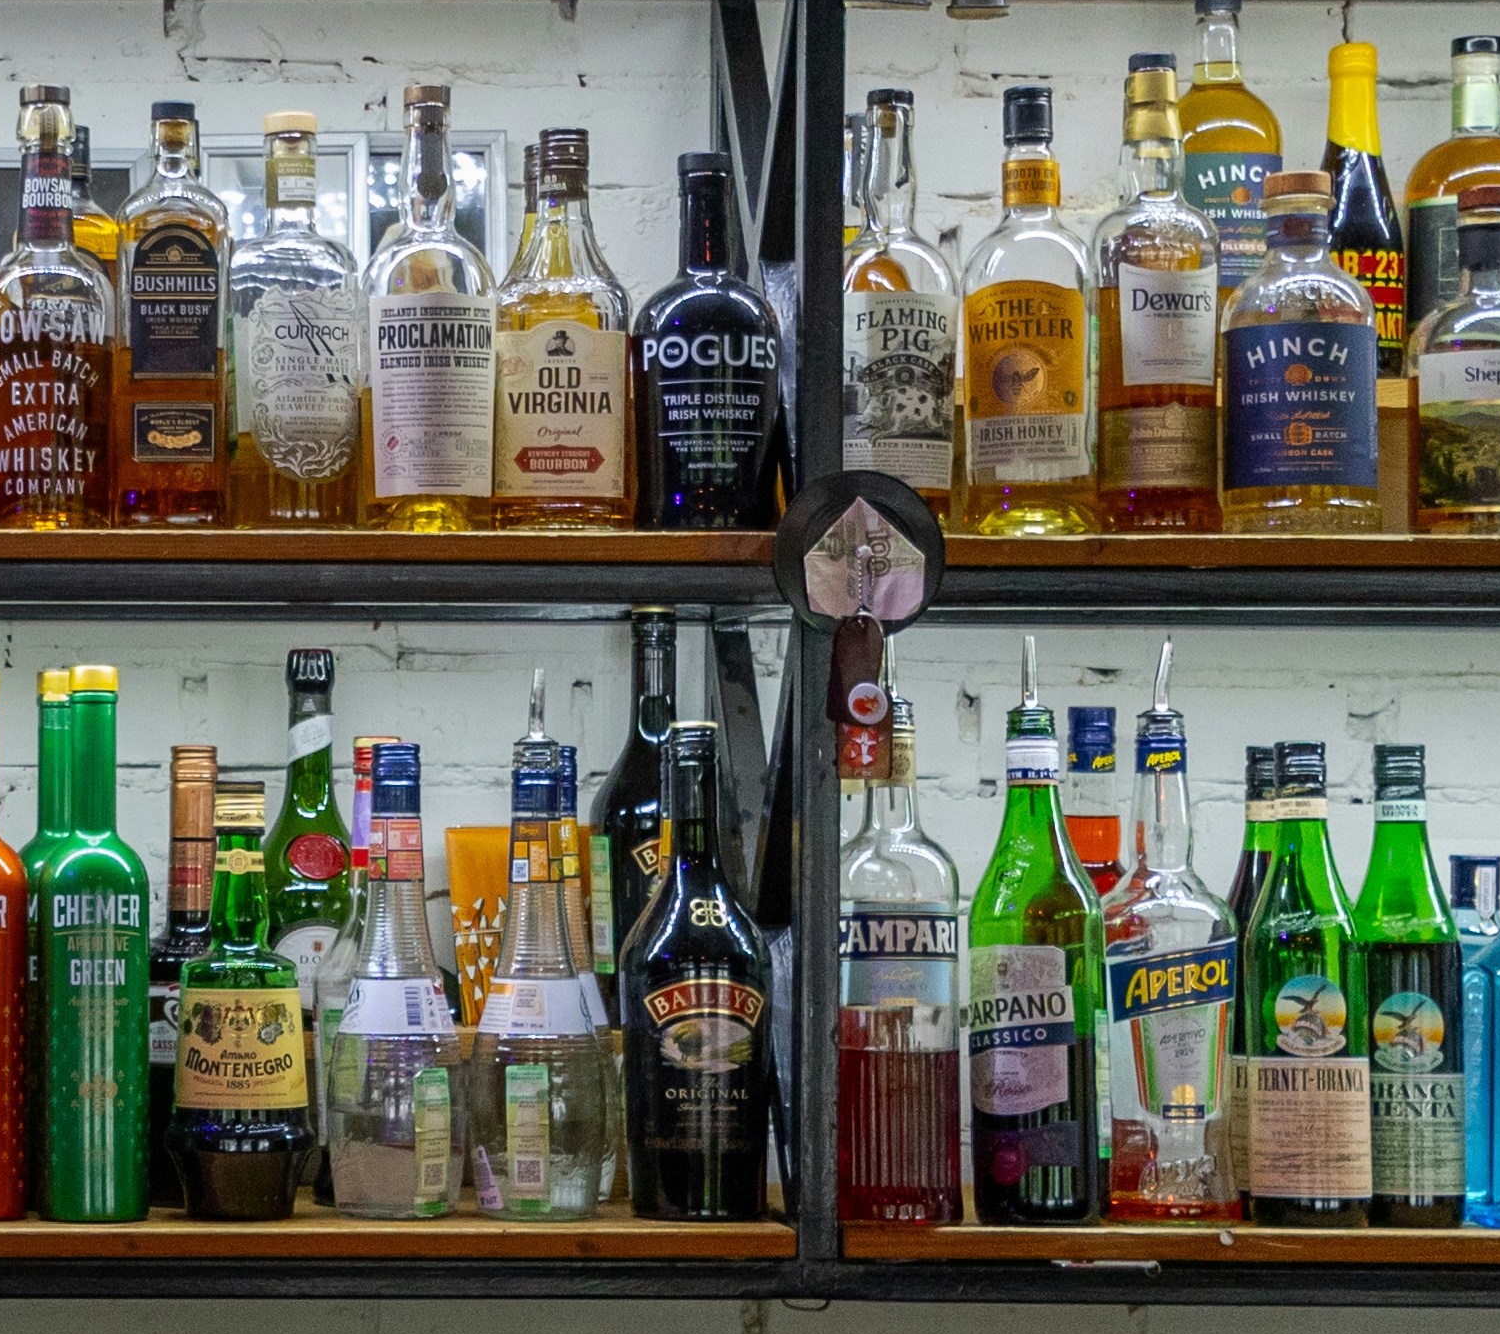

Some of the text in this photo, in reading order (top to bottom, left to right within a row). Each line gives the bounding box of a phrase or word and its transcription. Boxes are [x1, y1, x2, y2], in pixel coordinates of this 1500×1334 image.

[134, 275, 217, 292] BUSHMILLS
[140, 304, 209, 316] BLACK BUSH
[996, 300, 1036, 318] THE
[1131, 287, 1211, 312] Dewar's
[855, 311, 948, 333] FLAMING
[968, 318, 1074, 343] WHISTLER
[275, 323, 350, 356] CURRACH
[378, 323, 492, 352] PROCLAMATION
[882, 327, 932, 353] PIG
[644, 335, 776, 372] POGUES
[1247, 335, 1350, 369] HINCH
[52, 350, 99, 387] BATCH
[538, 366, 581, 390] OLD
[10, 382, 80, 406] EXTRA
[508, 392, 612, 415] VIRGINIA
[663, 394, 760, 406] TRIPLE DISTILLED
[1241, 390, 1356, 405] IRISH WHISKEY
[669, 409, 755, 422] IRISH WHISKEY
[3, 415, 88, 442] AMERICAN
[536, 425, 583, 439] Original
[979, 424, 1063, 440] IRISH HONEY
[1250, 430, 1348, 442] SMALL BATCH
[529, 458, 588, 472] BOURBON
[5, 477, 85, 497] COMPANY
[52, 894, 141, 929] CHEMER
[70, 960, 126, 986] GREEN
[1125, 960, 1229, 1009] APEROL
[652, 984, 758, 1023] BAILEYS
[185, 1049, 294, 1077] MONTENEGRO
[220, 1050, 257, 1061] AMARO
[1174, 1047, 1194, 1059] 1919
[226, 1079, 250, 1089] 1885
[664, 1087, 750, 1101] ORIGINAL
